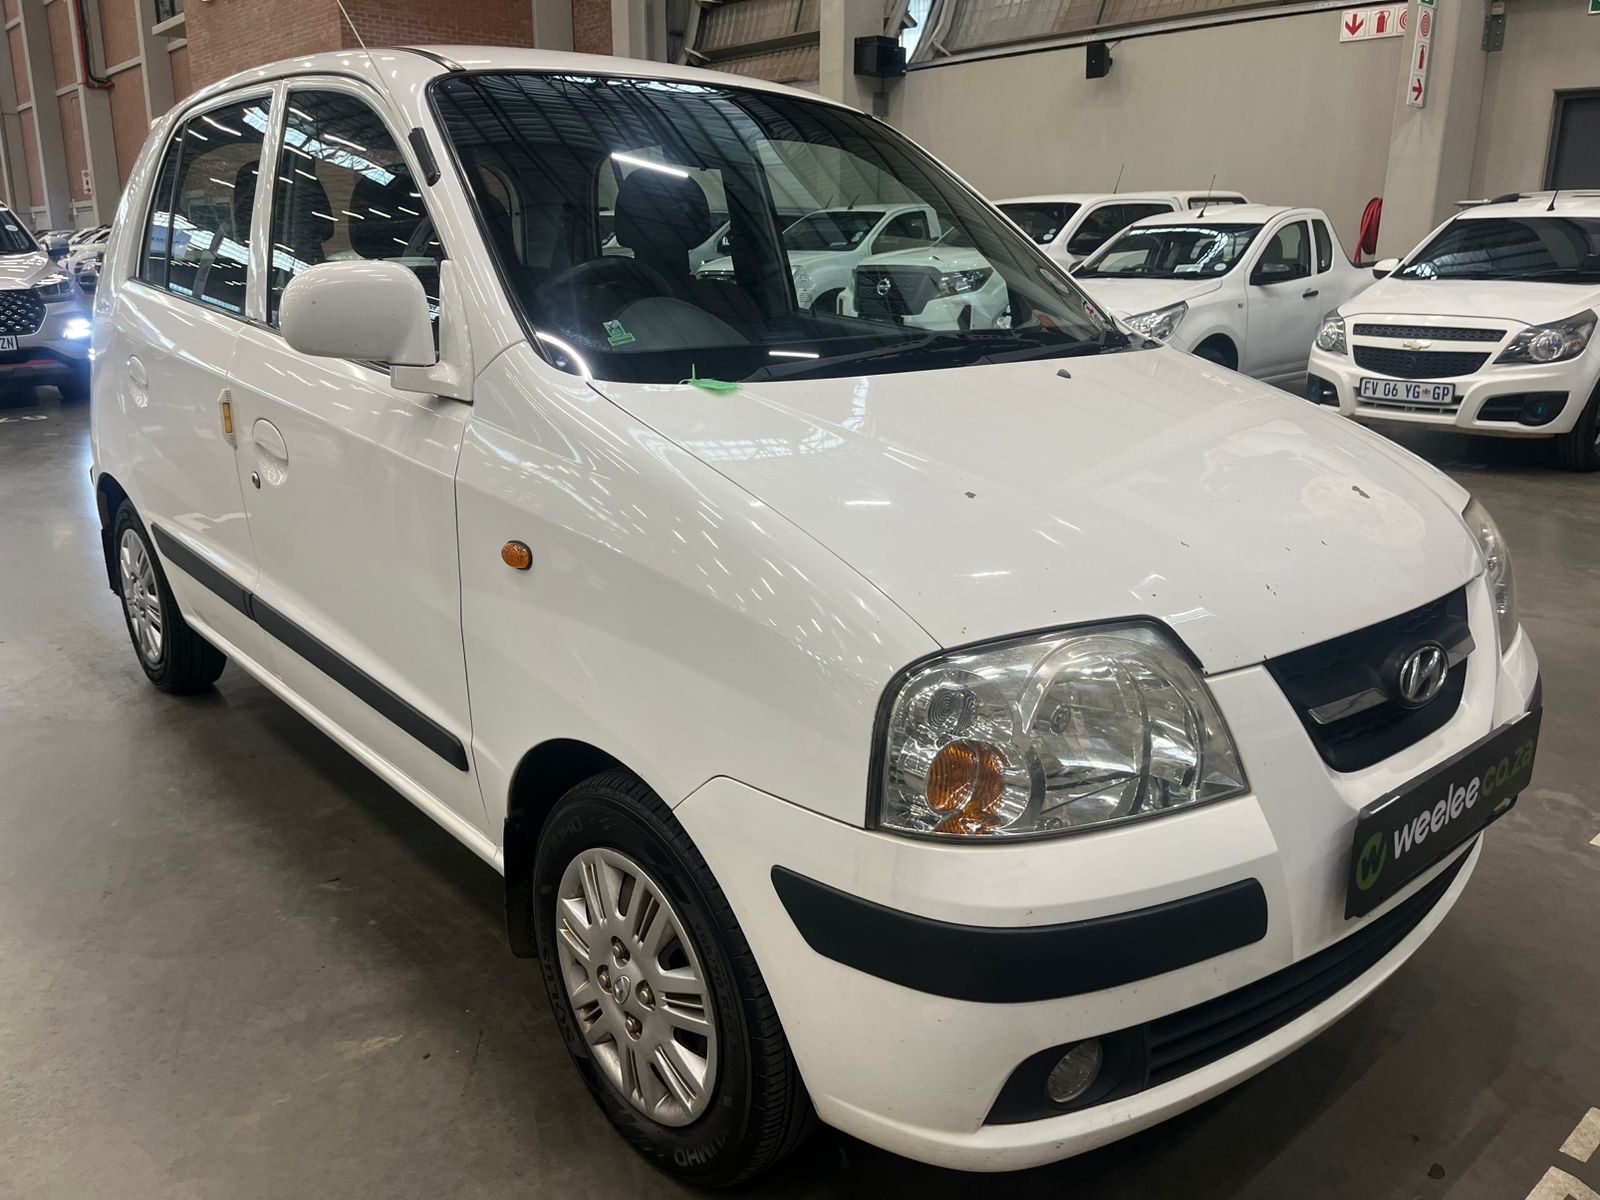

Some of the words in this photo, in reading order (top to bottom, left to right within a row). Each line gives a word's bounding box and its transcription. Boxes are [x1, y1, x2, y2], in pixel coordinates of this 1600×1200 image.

[1363, 381, 1379, 396] FV
[1383, 382, 1399, 397] 06
[1405, 383, 1421, 399] YG
[1432, 386, 1450, 401] GP
